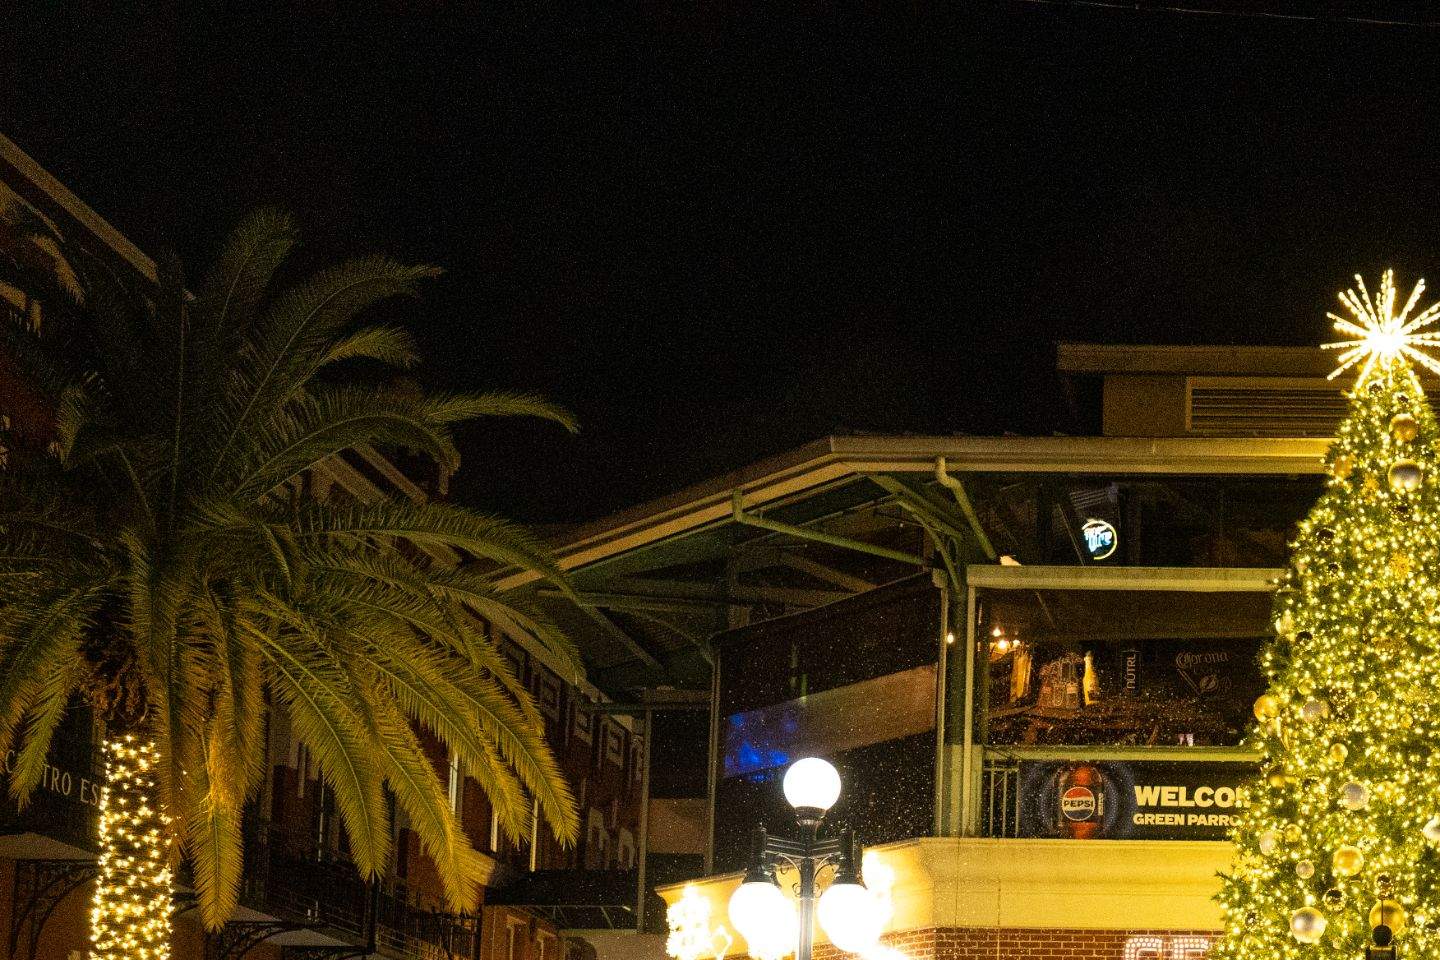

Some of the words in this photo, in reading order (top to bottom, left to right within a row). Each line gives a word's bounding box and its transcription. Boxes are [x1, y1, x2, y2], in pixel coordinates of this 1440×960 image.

[5, 749, 72, 796] CTRO
[1063, 800, 1094, 808] PEPSI
[1133, 814, 1185, 826] GREEN
